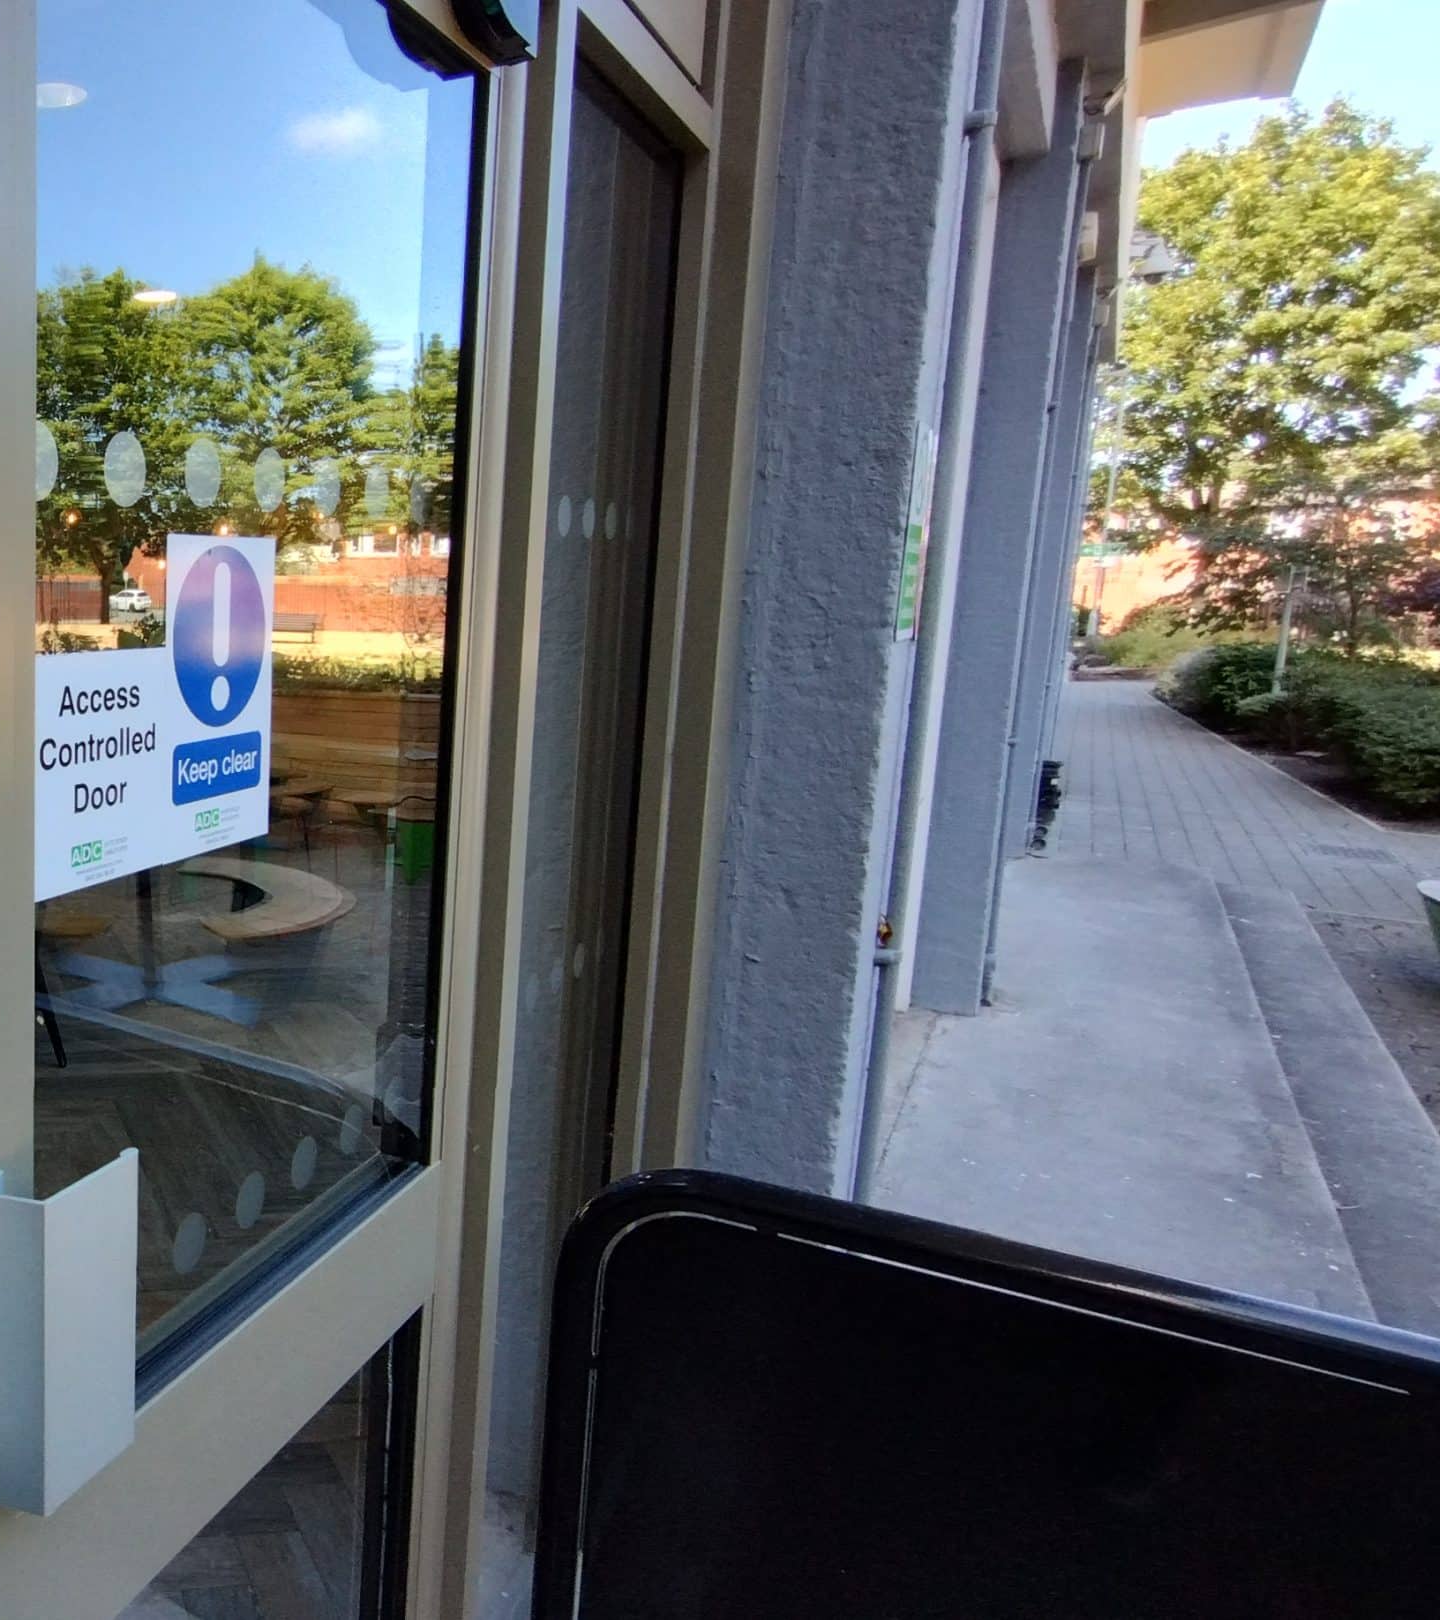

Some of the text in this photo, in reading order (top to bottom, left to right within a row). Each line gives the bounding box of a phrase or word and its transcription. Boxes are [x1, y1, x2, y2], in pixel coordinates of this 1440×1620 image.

[59, 685, 140, 717] Access
[40, 723, 155, 770] Controlled
[178, 749, 258, 785] Keep clear
[74, 782, 127, 813] Door
[195, 808, 219, 832] ADC
[71, 840, 102, 867] ADC
